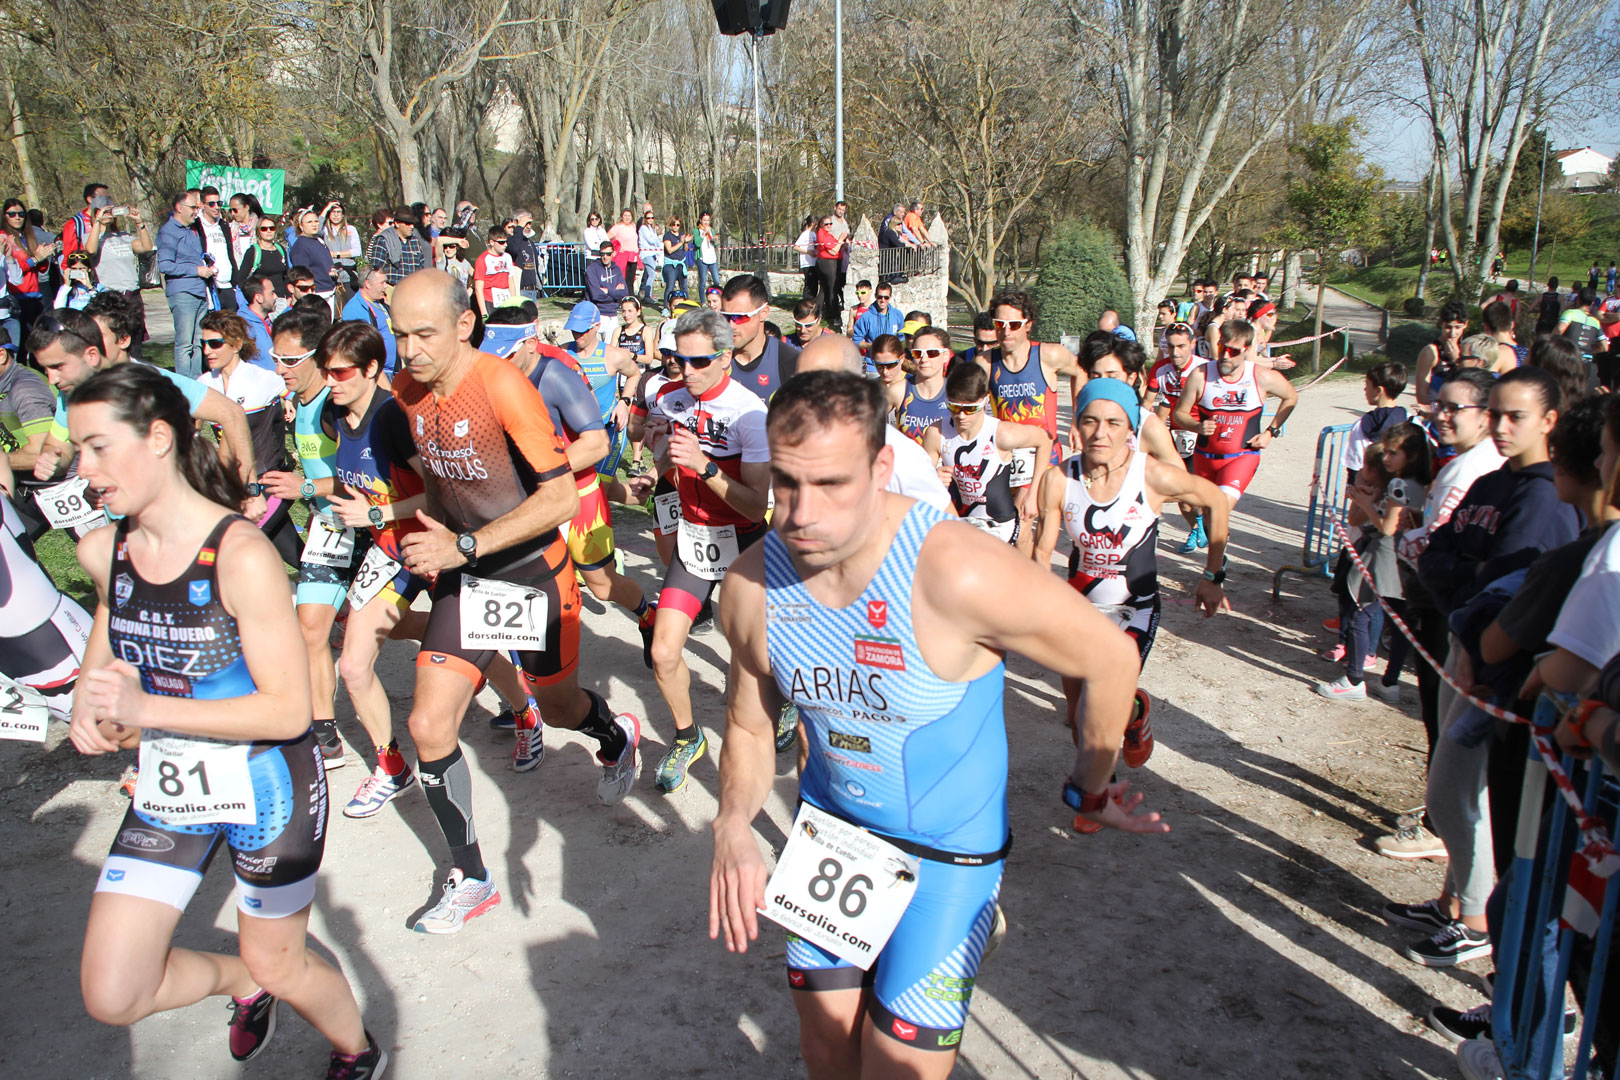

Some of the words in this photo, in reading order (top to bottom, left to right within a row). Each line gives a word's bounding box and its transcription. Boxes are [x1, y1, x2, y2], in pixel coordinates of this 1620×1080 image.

[998, 382, 1037, 398] GREGORIS
[1215, 415, 1226, 425] SAN
[1227, 416, 1244, 425] JUAN
[336, 467, 373, 490] ELGADO
[960, 481, 982, 494] ESP
[54, 494, 82, 516] 89
[53, 509, 97, 525] dorsalia.com
[1079, 528, 1124, 550] GARCÍA
[307, 549, 349, 561] dorsalia.com
[693, 541, 721, 563] 60
[1082, 551, 1121, 566] ESP
[355, 562, 379, 589] 83
[483, 599, 524, 628] 82
[111, 615, 151, 637] LAGUNA
[152, 623, 169, 640] DE
[169, 626, 216, 642] DUERO
[467, 631, 540, 642] dorsalia.com
[120, 639, 207, 676] DIEZ
[865, 651, 904, 667] ZAMORA
[790, 666, 888, 711] ARIAS
[852, 709, 891, 724] PACO
[158, 760, 211, 797] 81
[142, 800, 246, 813] dorsalia.com
[808, 857, 874, 918] 86
[774, 894, 872, 953] dorsalia.com
